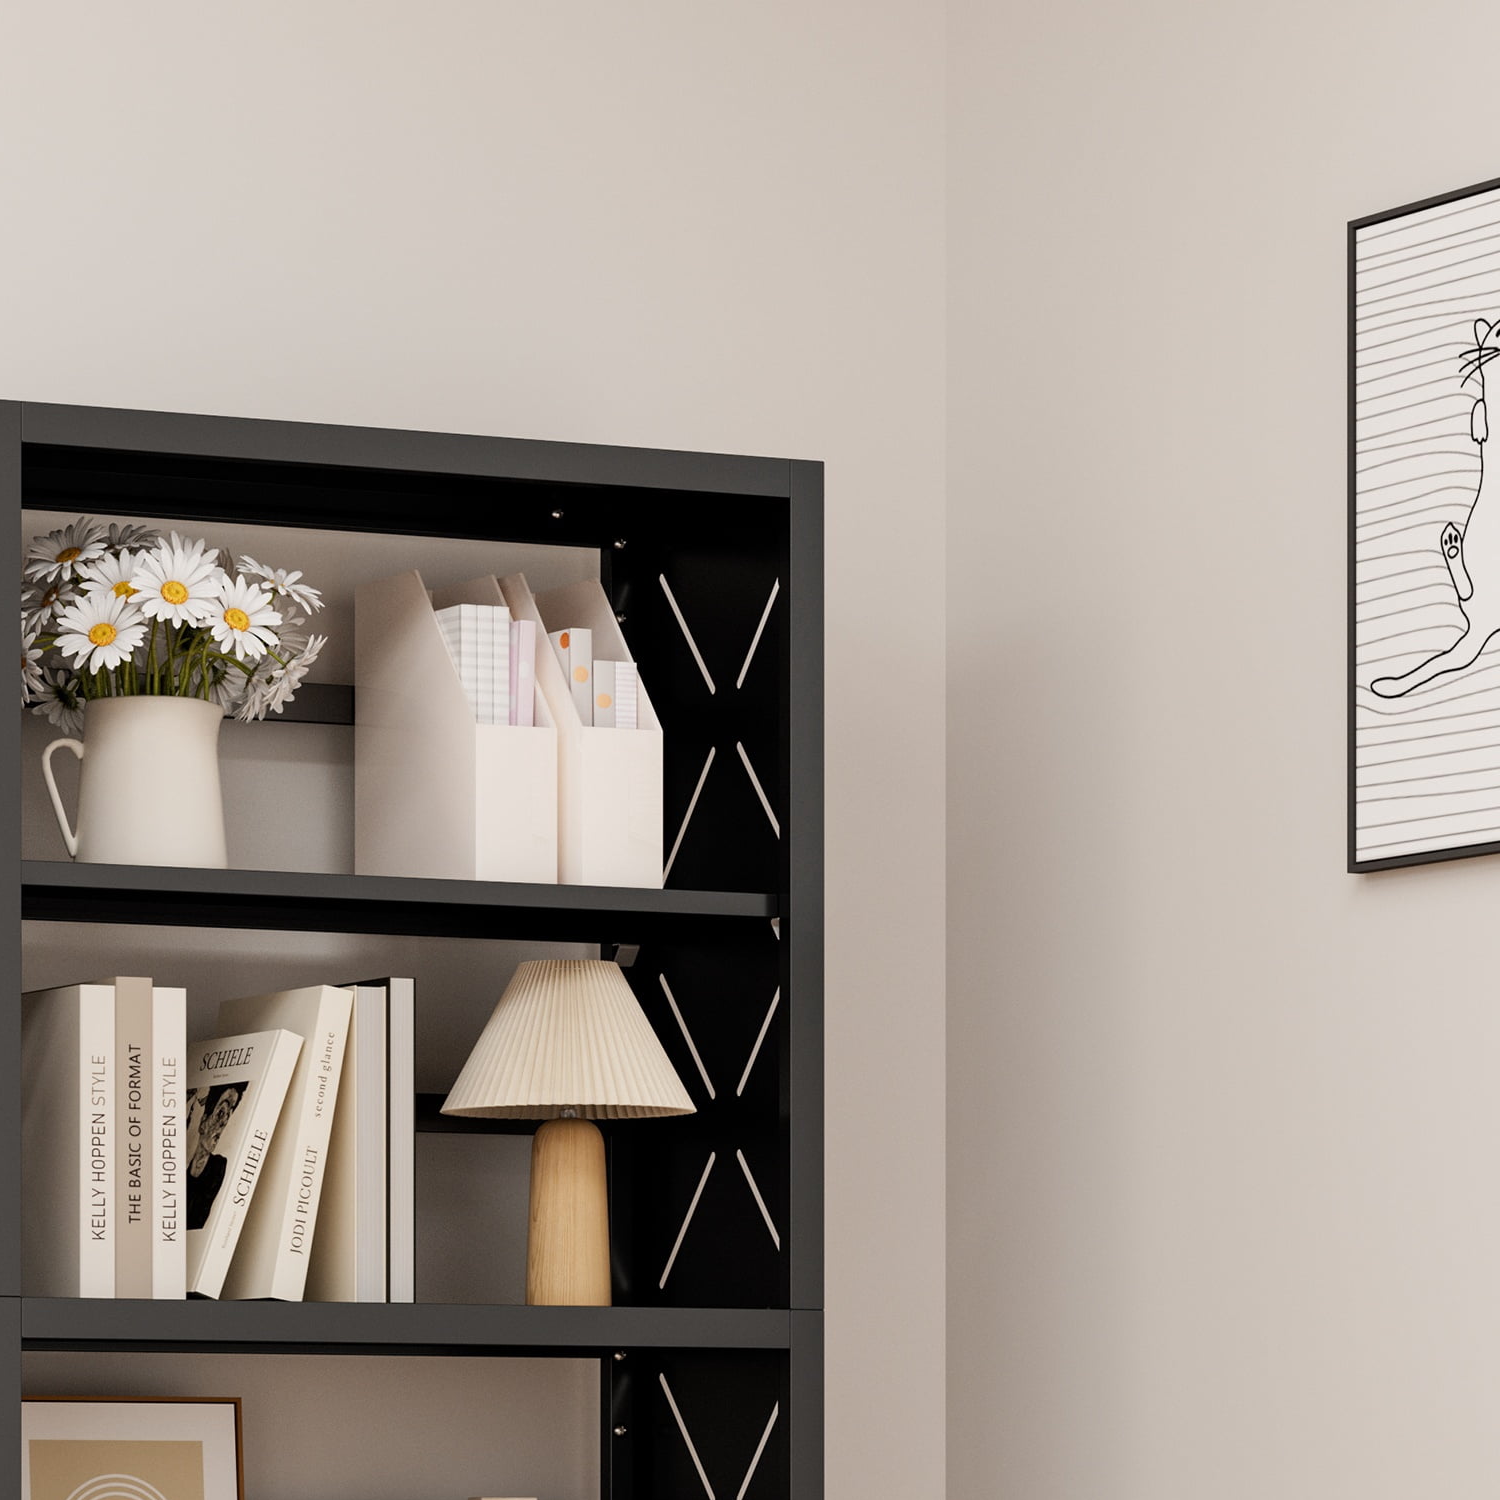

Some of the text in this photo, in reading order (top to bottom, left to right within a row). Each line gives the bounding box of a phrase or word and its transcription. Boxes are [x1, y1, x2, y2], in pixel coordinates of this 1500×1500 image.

[199, 1046, 254, 1072] SCHIELE
[315, 1032, 335, 1118] second glance
[91, 1055, 106, 1240] KELLY HOPPEN STYLE
[128, 1044, 141, 1224] THE BASIC OF FORMAT
[162, 1057, 177, 1242] KELLY HOPPEN STYLE
[233, 1129, 268, 1207] SCHIELE
[289, 1145, 319, 1255] JODI PICOULT
